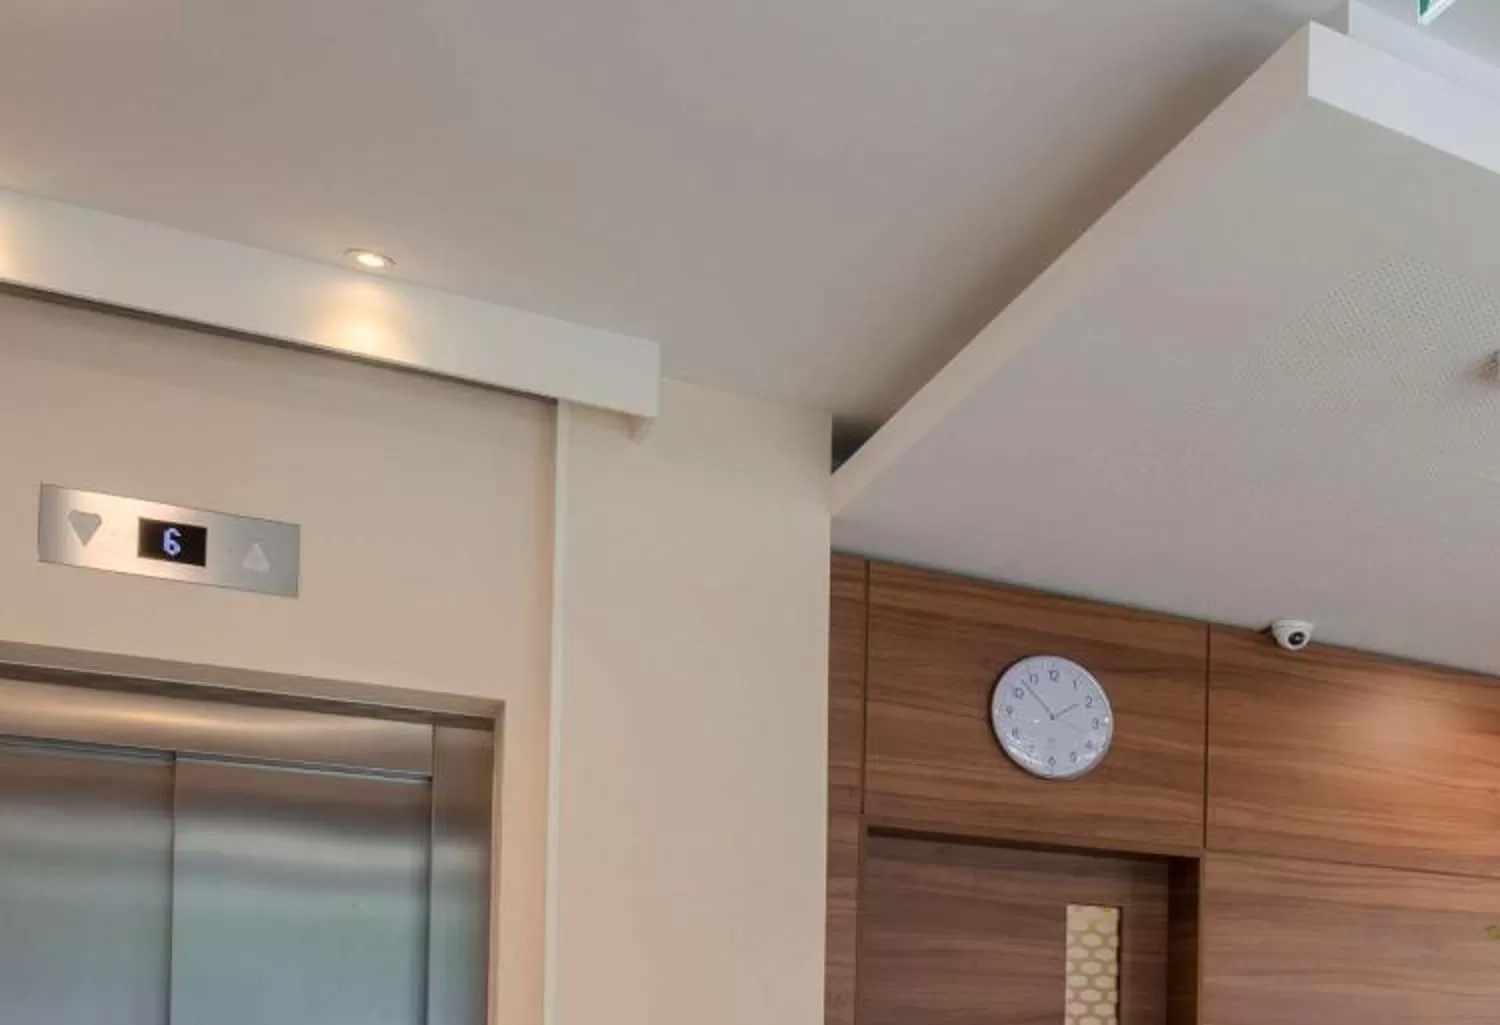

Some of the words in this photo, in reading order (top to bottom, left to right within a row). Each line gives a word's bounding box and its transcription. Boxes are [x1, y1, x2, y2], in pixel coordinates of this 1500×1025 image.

[162, 527, 182, 556] 6
[1085, 695, 1093, 708] 2
[1091, 718, 1099, 730] 3
